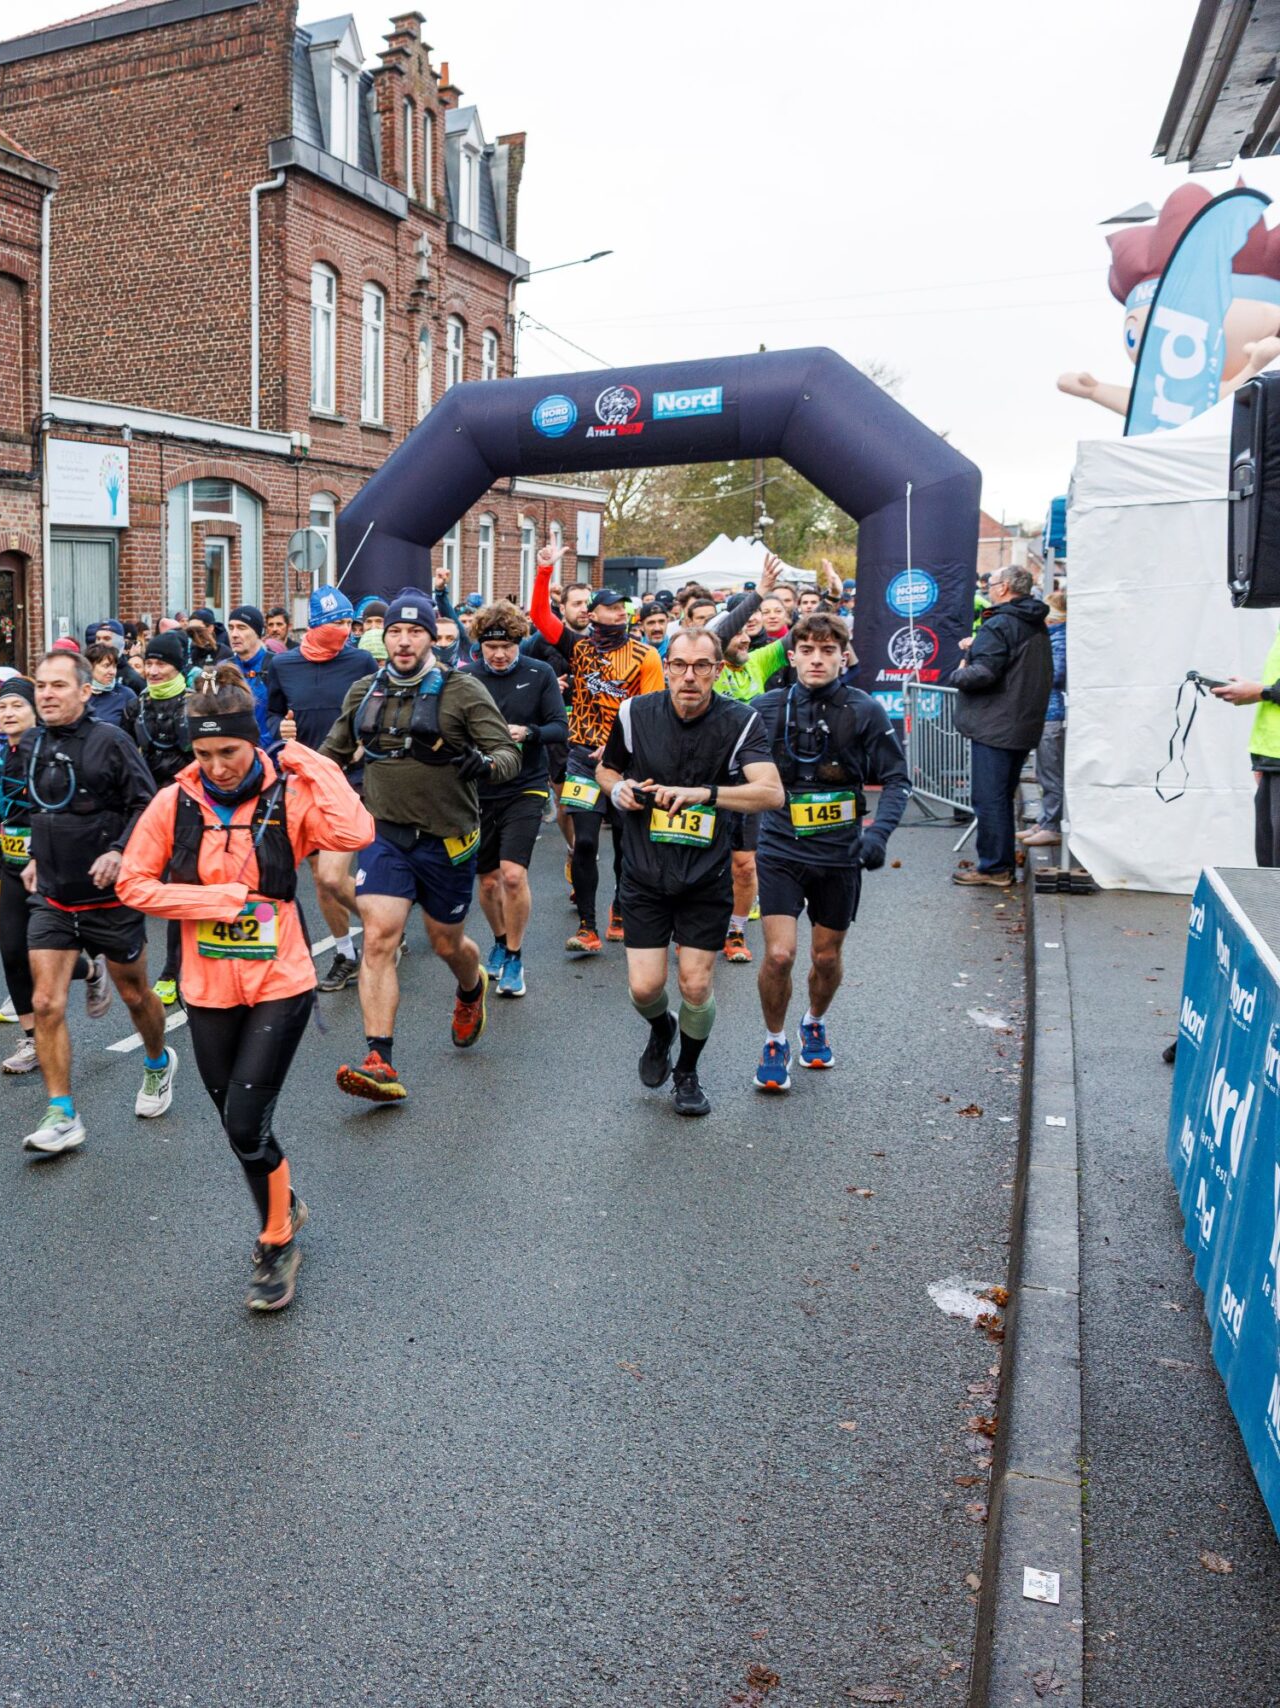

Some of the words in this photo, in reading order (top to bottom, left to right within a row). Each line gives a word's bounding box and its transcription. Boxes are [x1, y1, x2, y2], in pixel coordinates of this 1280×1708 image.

[658, 390, 718, 412] Nord
[542, 407, 568, 418] NORD
[606, 415, 628, 425] FFA
[572, 785, 582, 796] 9
[668, 813, 702, 832] 113
[805, 805, 841, 822] 145
[213, 919, 259, 942] 462
[1180, 996, 1207, 1043] Nord
[1222, 1283, 1245, 1339] ord
